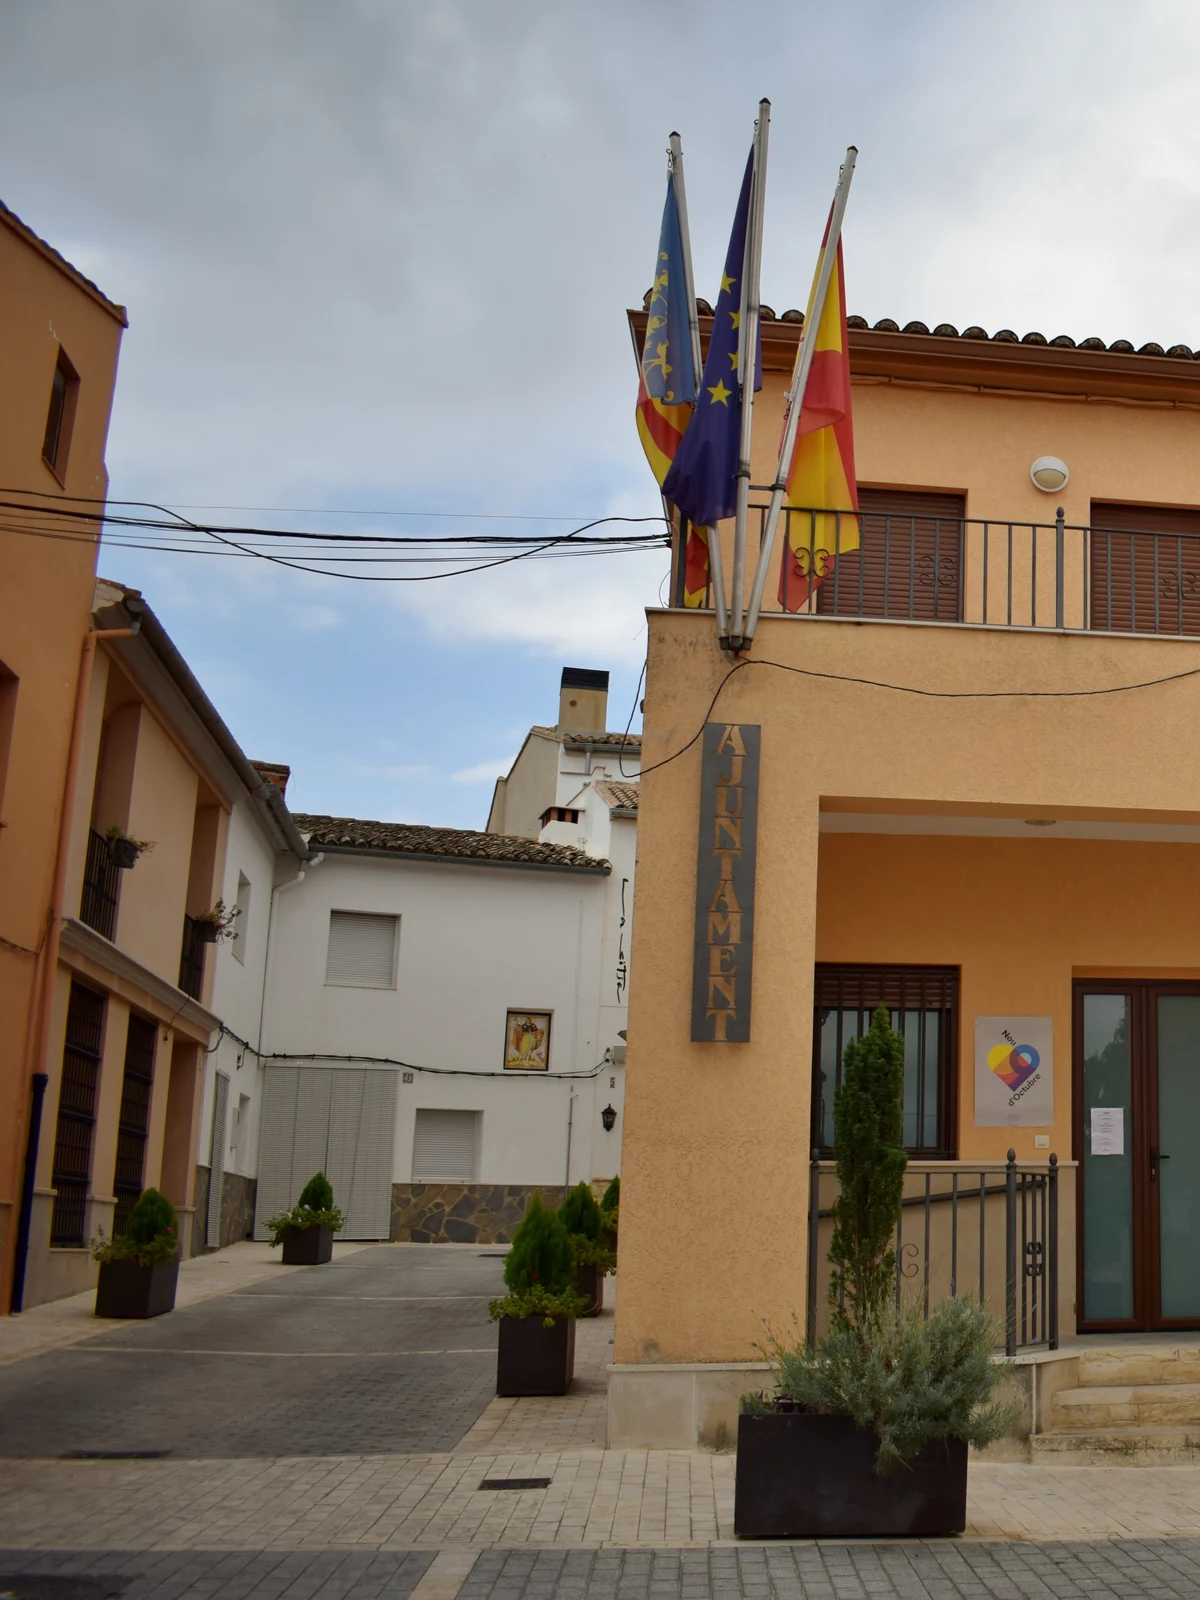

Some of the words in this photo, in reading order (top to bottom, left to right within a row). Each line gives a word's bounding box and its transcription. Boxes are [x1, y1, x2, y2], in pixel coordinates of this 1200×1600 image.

[705, 724, 748, 1041] AJUNTAMENT
[1001, 1029, 1017, 1046] Nou
[1008, 1073, 1041, 1107] d'Octubre
